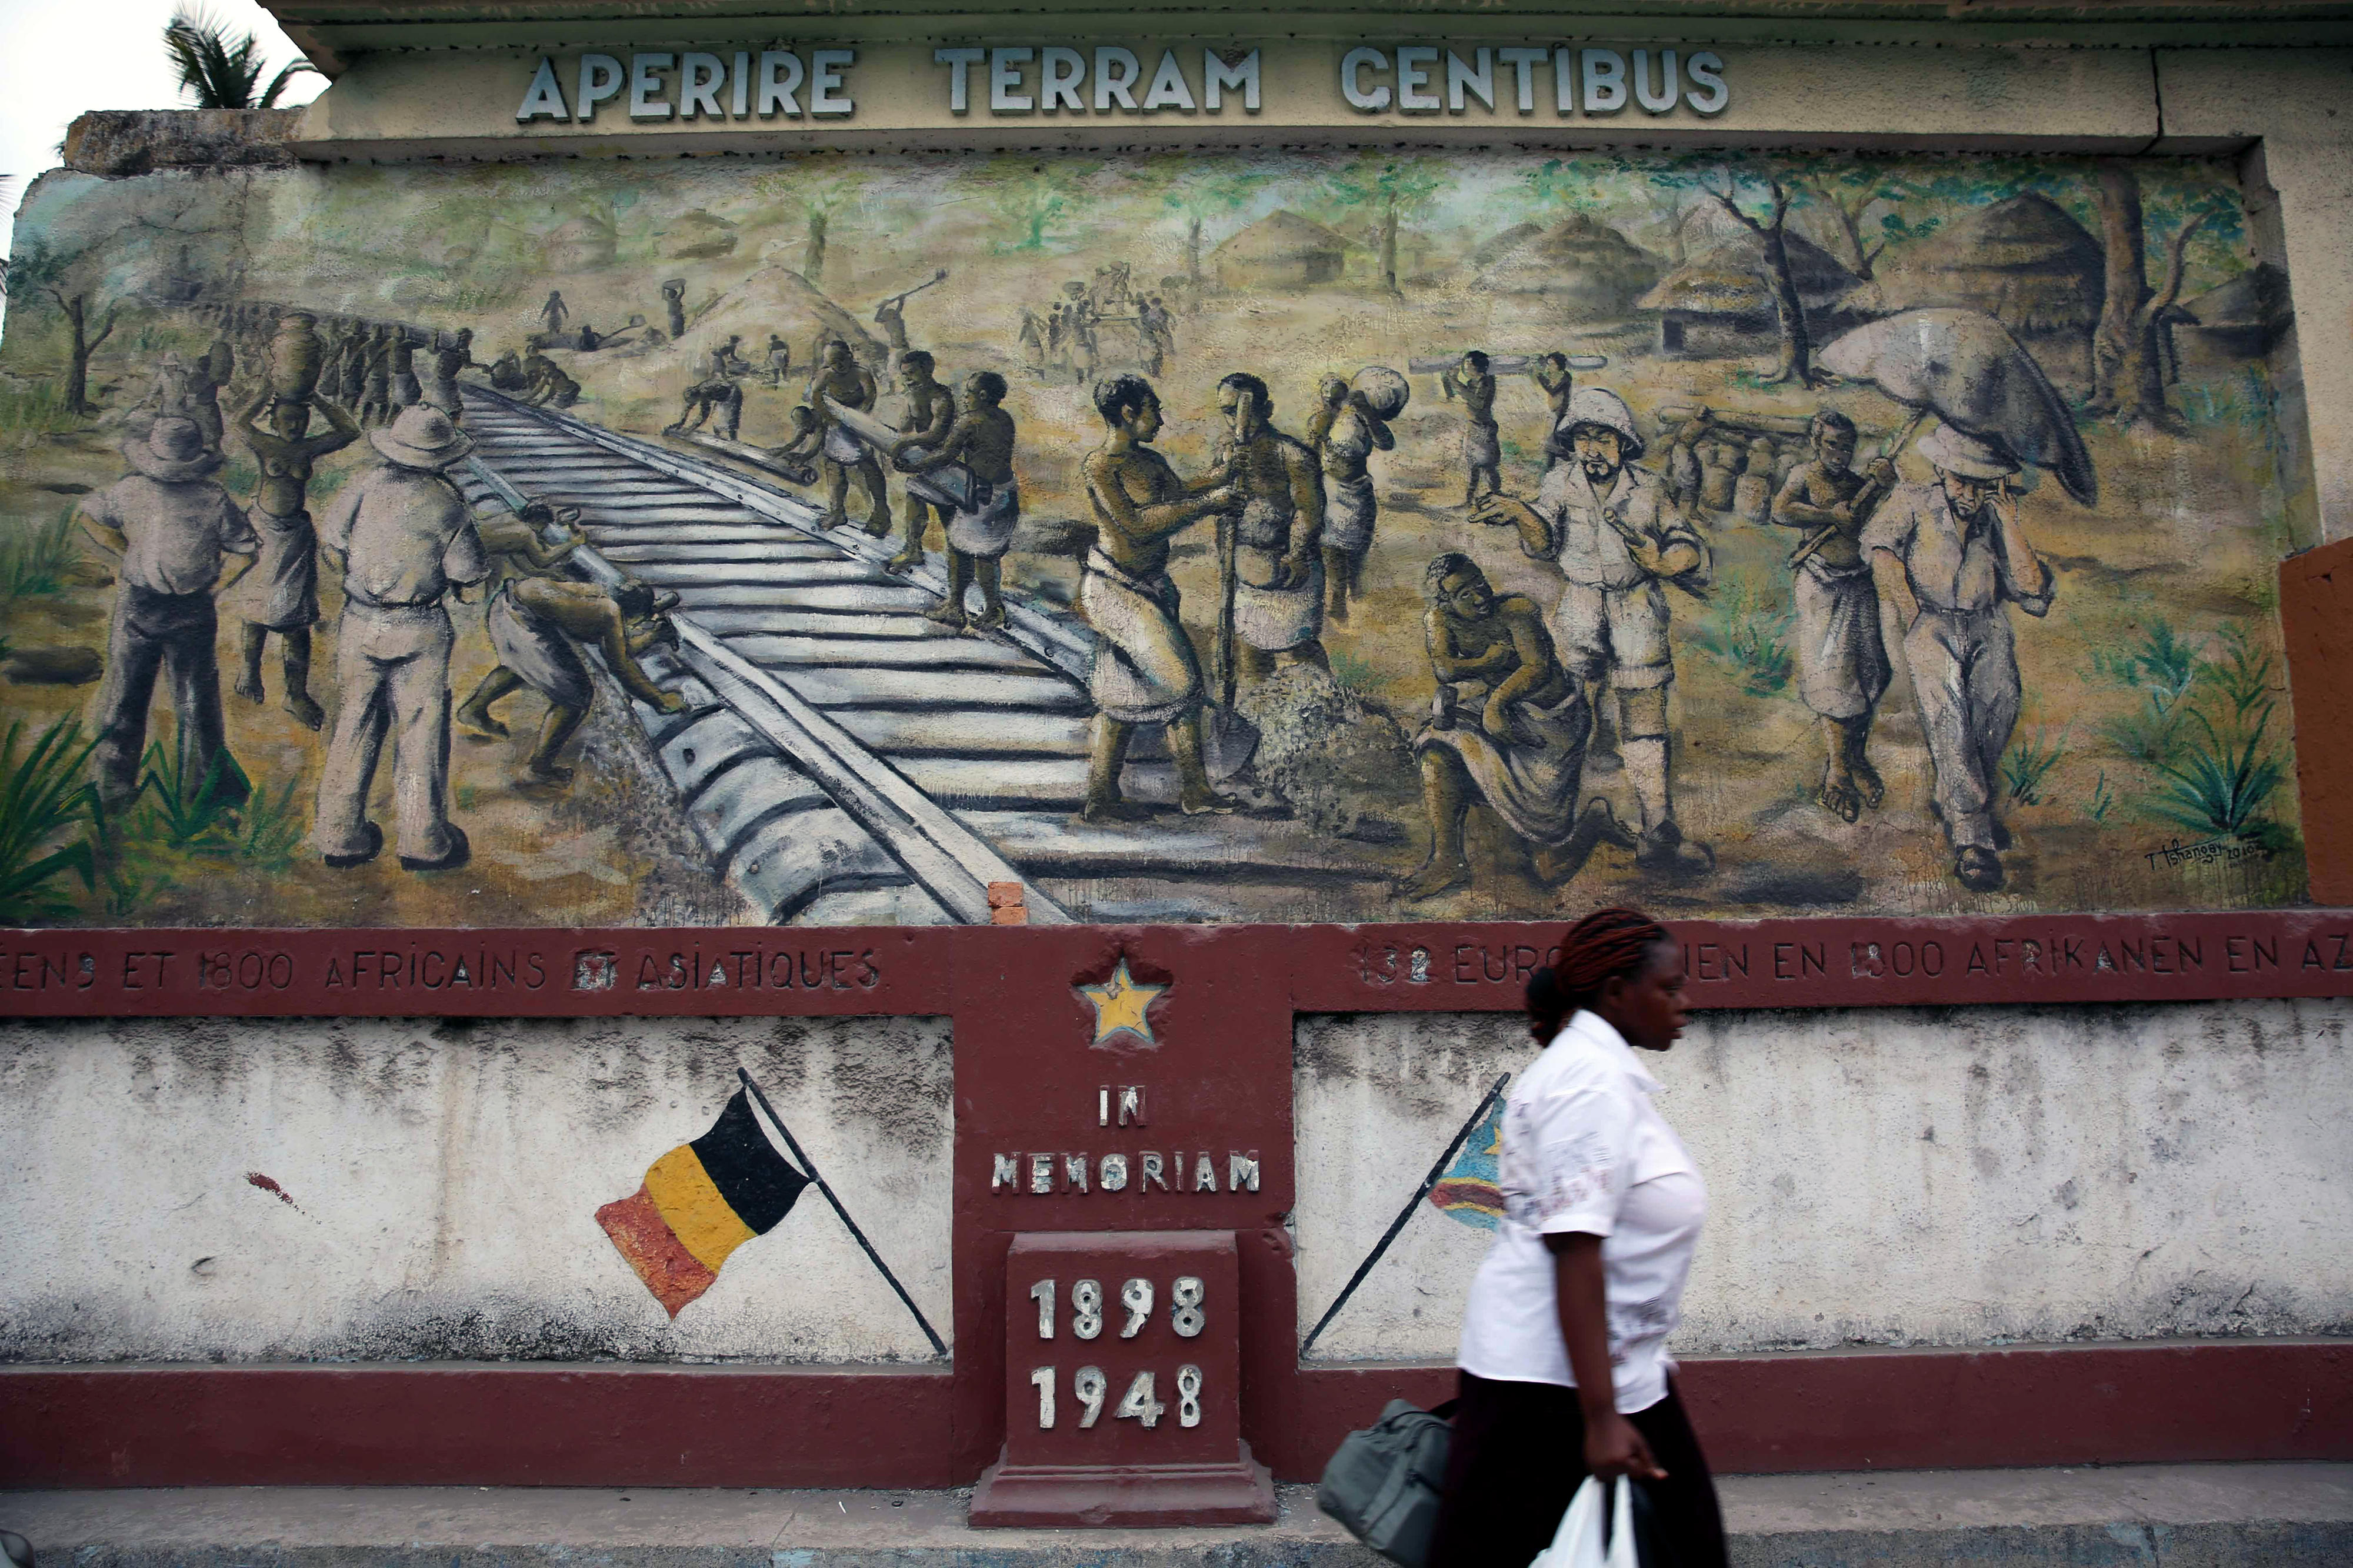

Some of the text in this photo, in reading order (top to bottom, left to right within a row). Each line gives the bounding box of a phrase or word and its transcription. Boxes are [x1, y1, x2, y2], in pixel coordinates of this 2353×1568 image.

[515, 49, 856, 123] APERIRE
[934, 46, 1261, 115] TERRAM
[123, 952, 176, 990] ET
[325, 941, 546, 990] AFRICAINS
[637, 941, 880, 990] ASIATIQUES
[1774, 940, 1827, 980] EN
[1966, 929, 2204, 977] AFRIKANEN
[2225, 935, 2279, 973] EN
[1099, 1084, 1146, 1127] IN
[991, 1150, 1260, 1194] MEMORIAM
[1029, 1277, 1205, 1340] 1898
[1031, 1363, 1205, 1429] 1948
